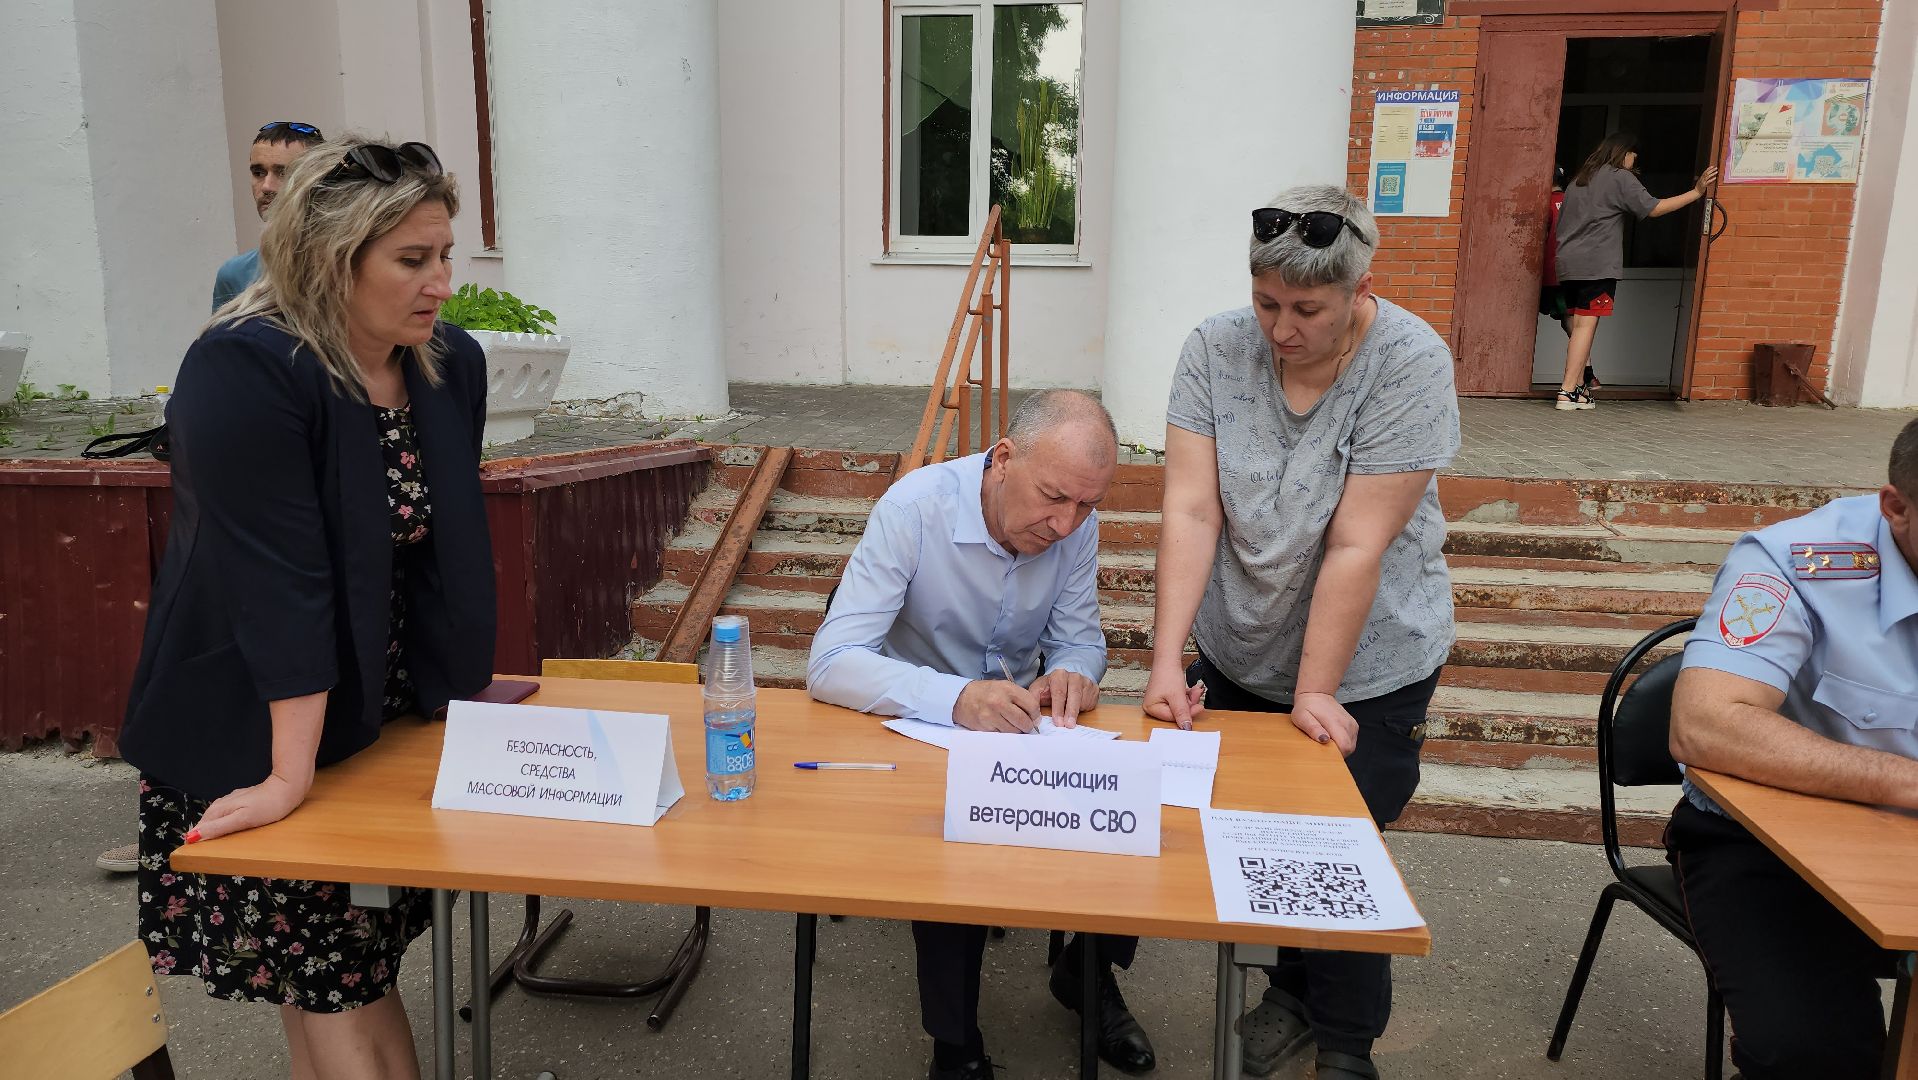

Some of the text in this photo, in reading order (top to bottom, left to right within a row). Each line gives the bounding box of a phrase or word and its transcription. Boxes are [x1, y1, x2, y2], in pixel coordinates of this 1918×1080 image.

[1378, 91, 1458, 102] ИНФОРМАЦИЯ
[506, 740, 597, 761] БЕЗОПАСНОСТЬ,
[520, 763, 576, 780] СРЕДСТВА
[990, 761, 1118, 792] Ассоциация
[467, 781, 623, 807] МАССОВОЙ ИНФОРМАЦИИ
[969, 805, 1137, 834] ветеранов СВО
